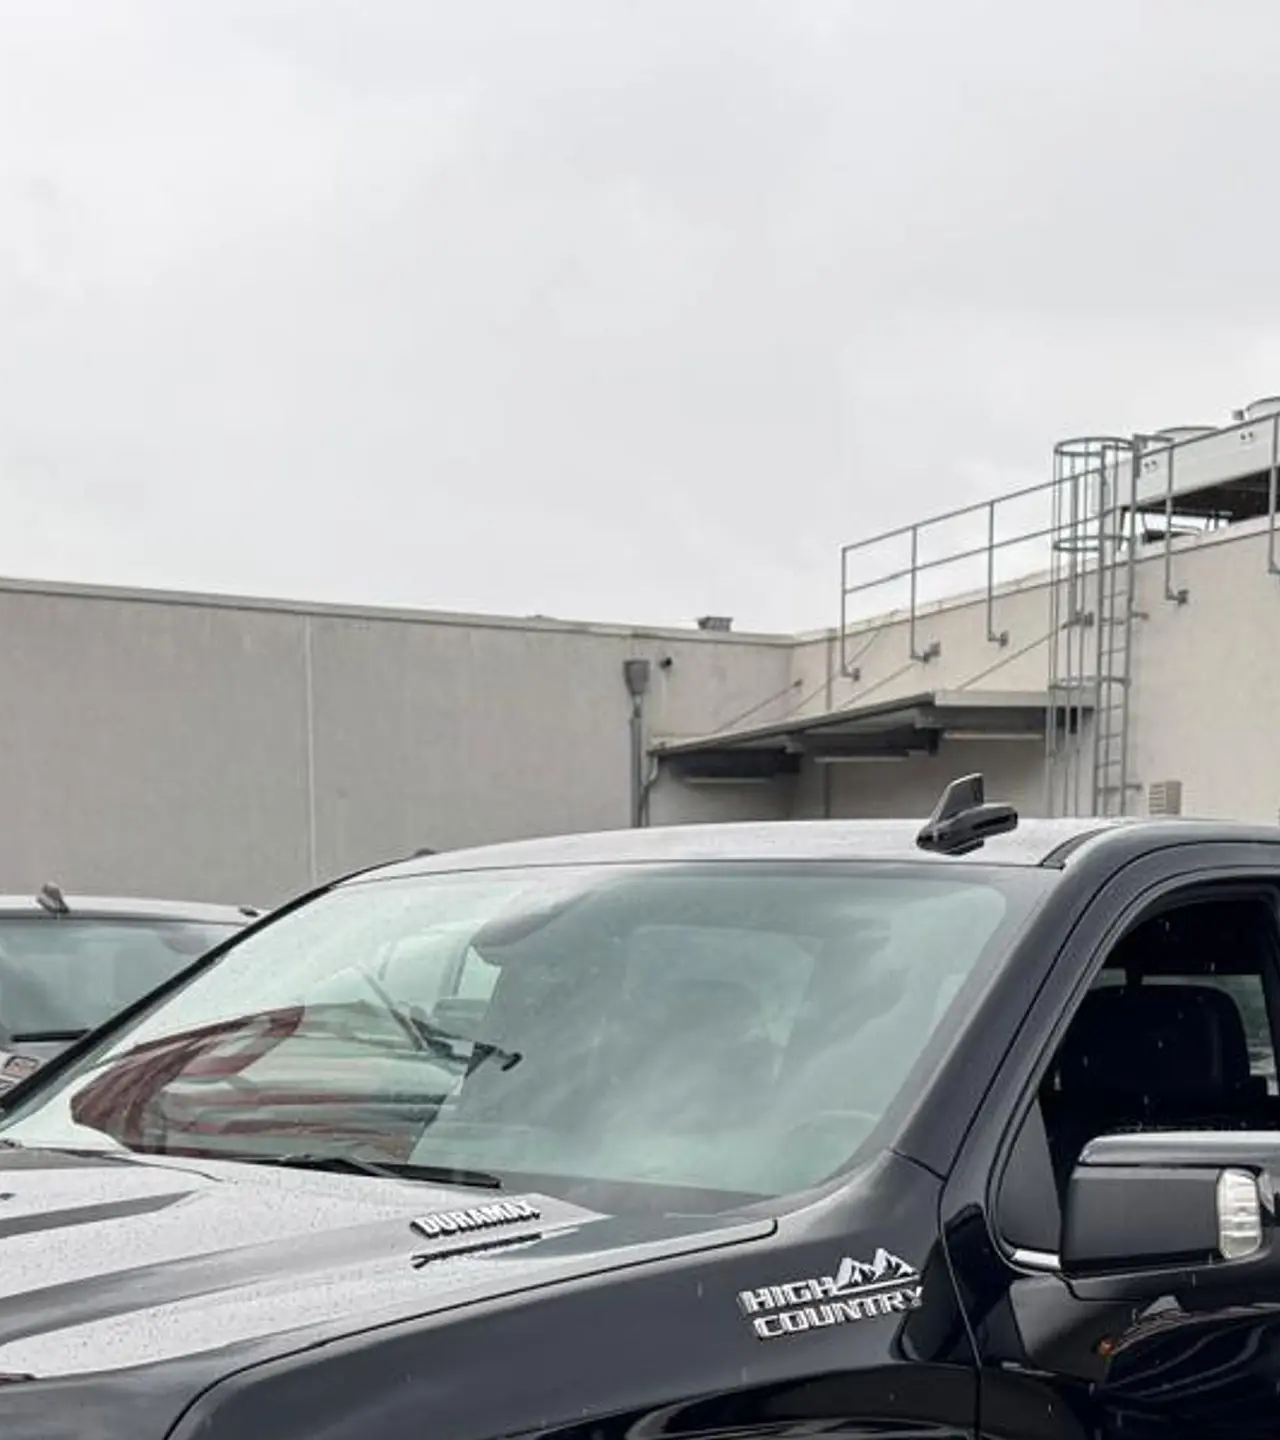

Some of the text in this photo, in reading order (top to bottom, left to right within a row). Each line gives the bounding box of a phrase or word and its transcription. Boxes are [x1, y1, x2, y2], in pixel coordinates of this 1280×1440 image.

[410, 1200, 541, 1239] DURAMAX
[737, 1276, 838, 1314] HIGH
[752, 1286, 924, 1338] COUNTRY
